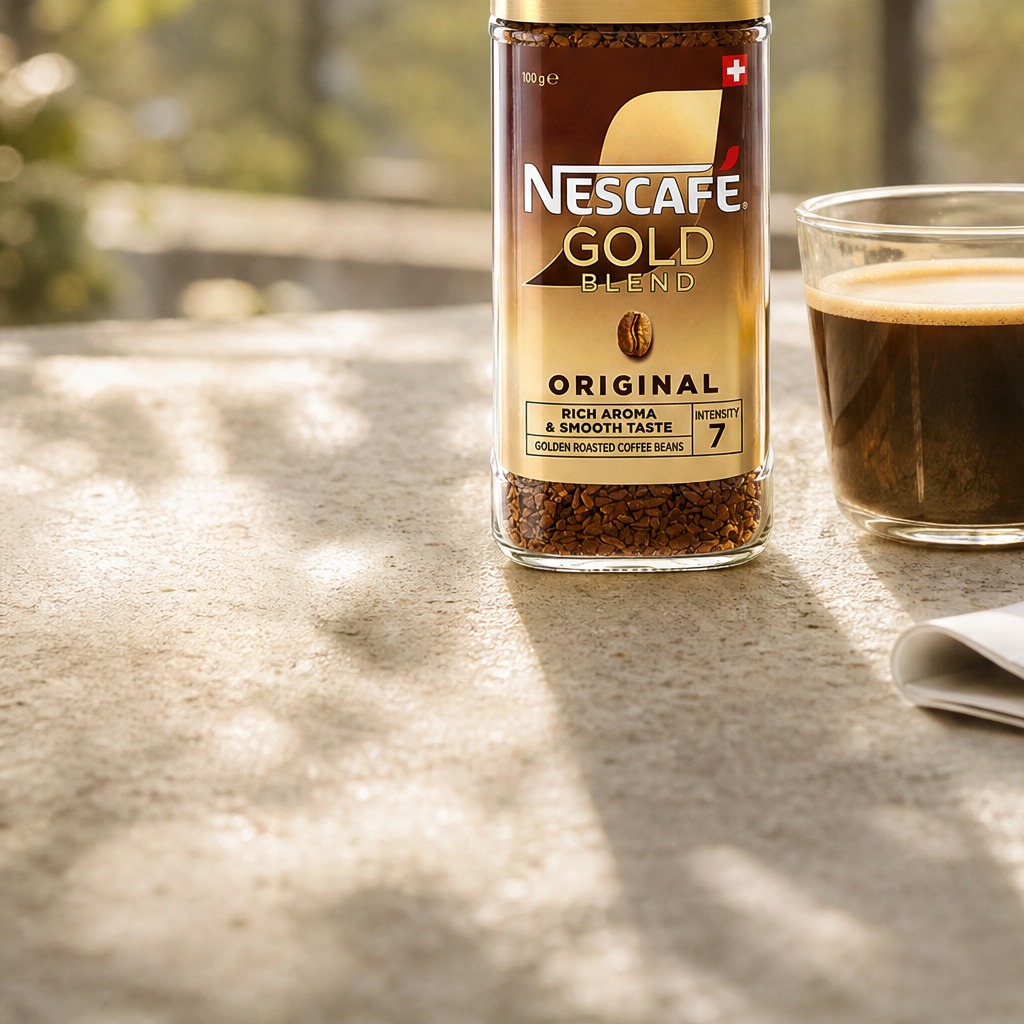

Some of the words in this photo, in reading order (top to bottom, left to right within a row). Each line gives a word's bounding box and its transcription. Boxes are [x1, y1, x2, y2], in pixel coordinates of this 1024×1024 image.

[524, 145, 741, 216] NESCAFÉ
[564, 226, 714, 267] GOLD
[581, 272, 695, 292] BLEND
[549, 374, 719, 395] ORIGINAL
[561, 409, 597, 419] RICH
[601, 409, 657, 419] AROMA
[695, 407, 740, 420] INTENSITY
[546, 423, 555, 433] &
[559, 423, 623, 434] SMOOTH
[627, 422, 673, 433] TASTE
[709, 423, 726, 448] 7
[535, 442, 571, 452] GOLDEN
[573, 442, 615, 453] ROASTED
[617, 442, 652, 452] COFFEE
[654, 441, 684, 452] BEANS
